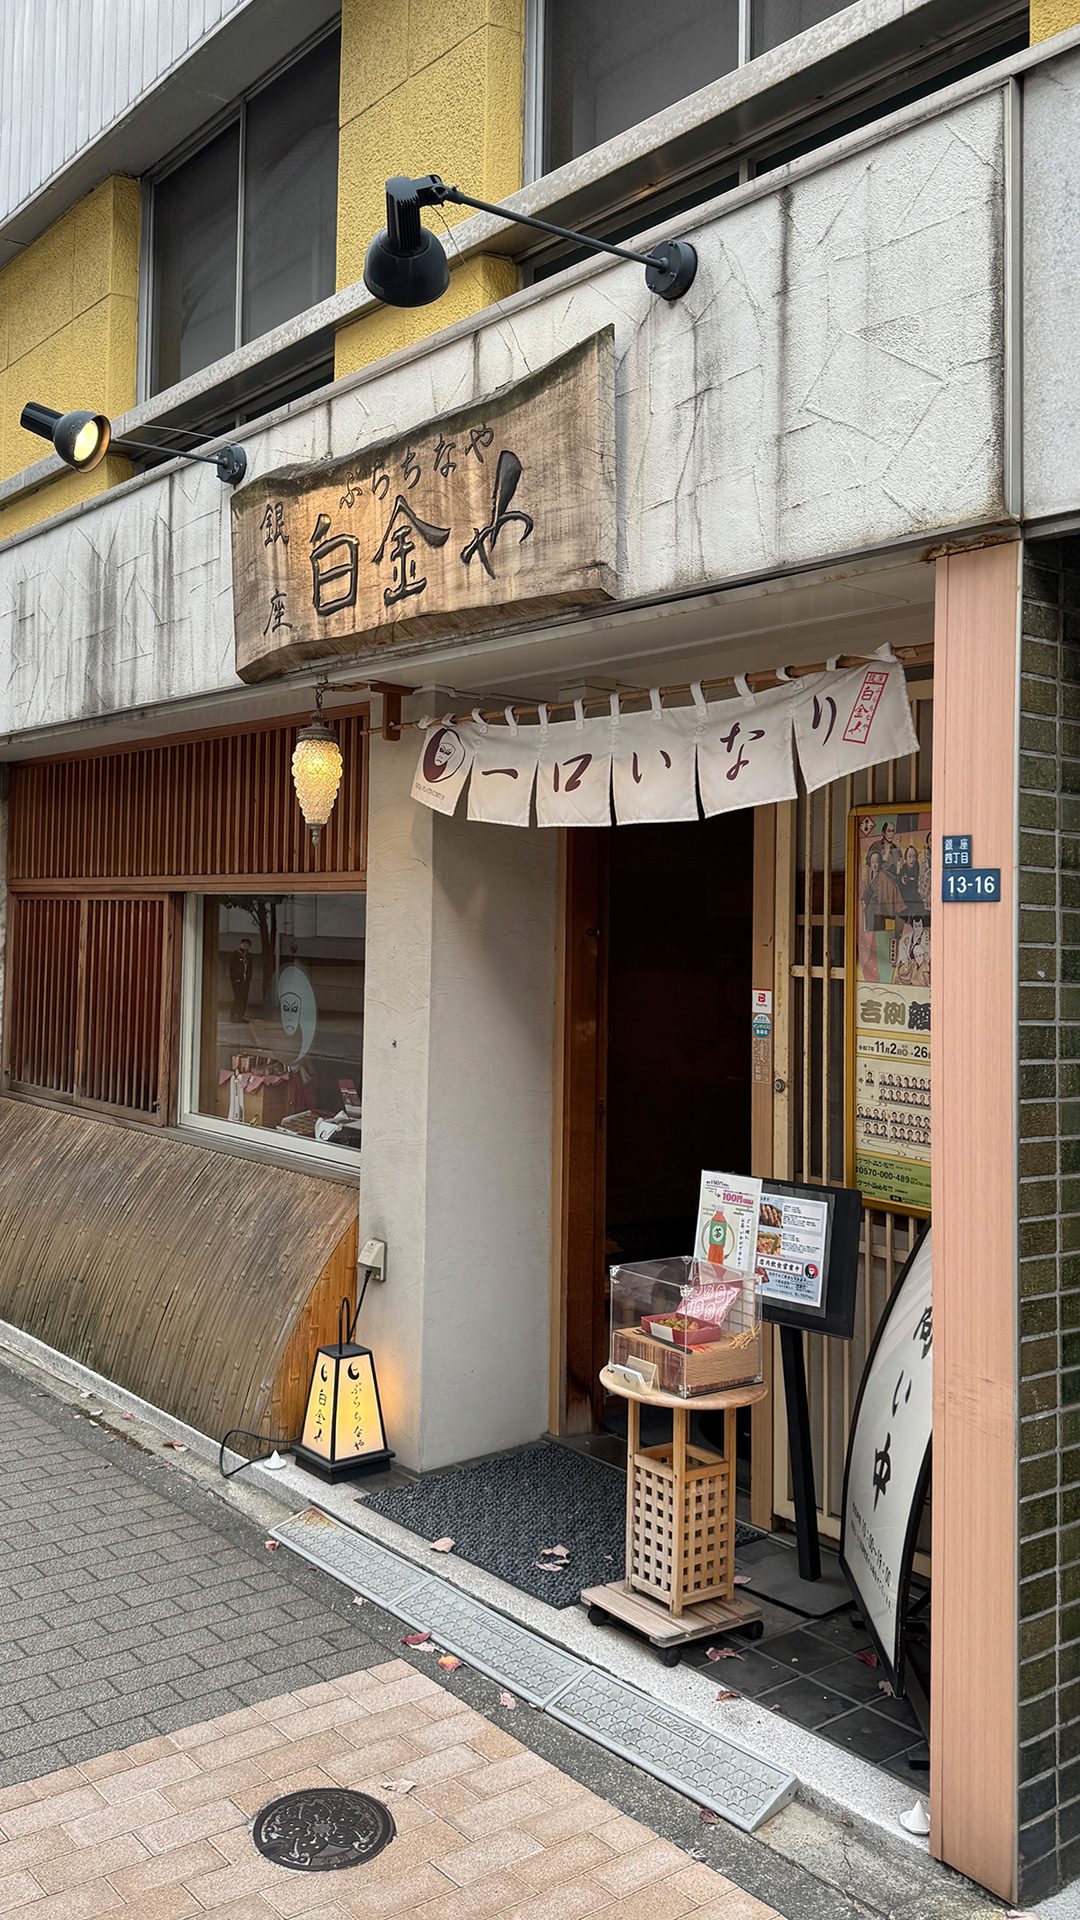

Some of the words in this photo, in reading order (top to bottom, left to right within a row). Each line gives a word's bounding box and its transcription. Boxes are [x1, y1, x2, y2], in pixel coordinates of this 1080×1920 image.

[308, 449, 534, 617] 白金や
[259, 500, 292, 637] 銀座
[848, 686, 874, 735] 白金や
[944, 838, 969, 851] 銀座
[944, 852, 969, 864] 四丁目
[947, 875, 995, 894] 13-16
[859, 1166, 910, 1184] 0570-000-489
[722, 1192, 743, 1203] 100円
[713, 1227, 722, 1239] 茶
